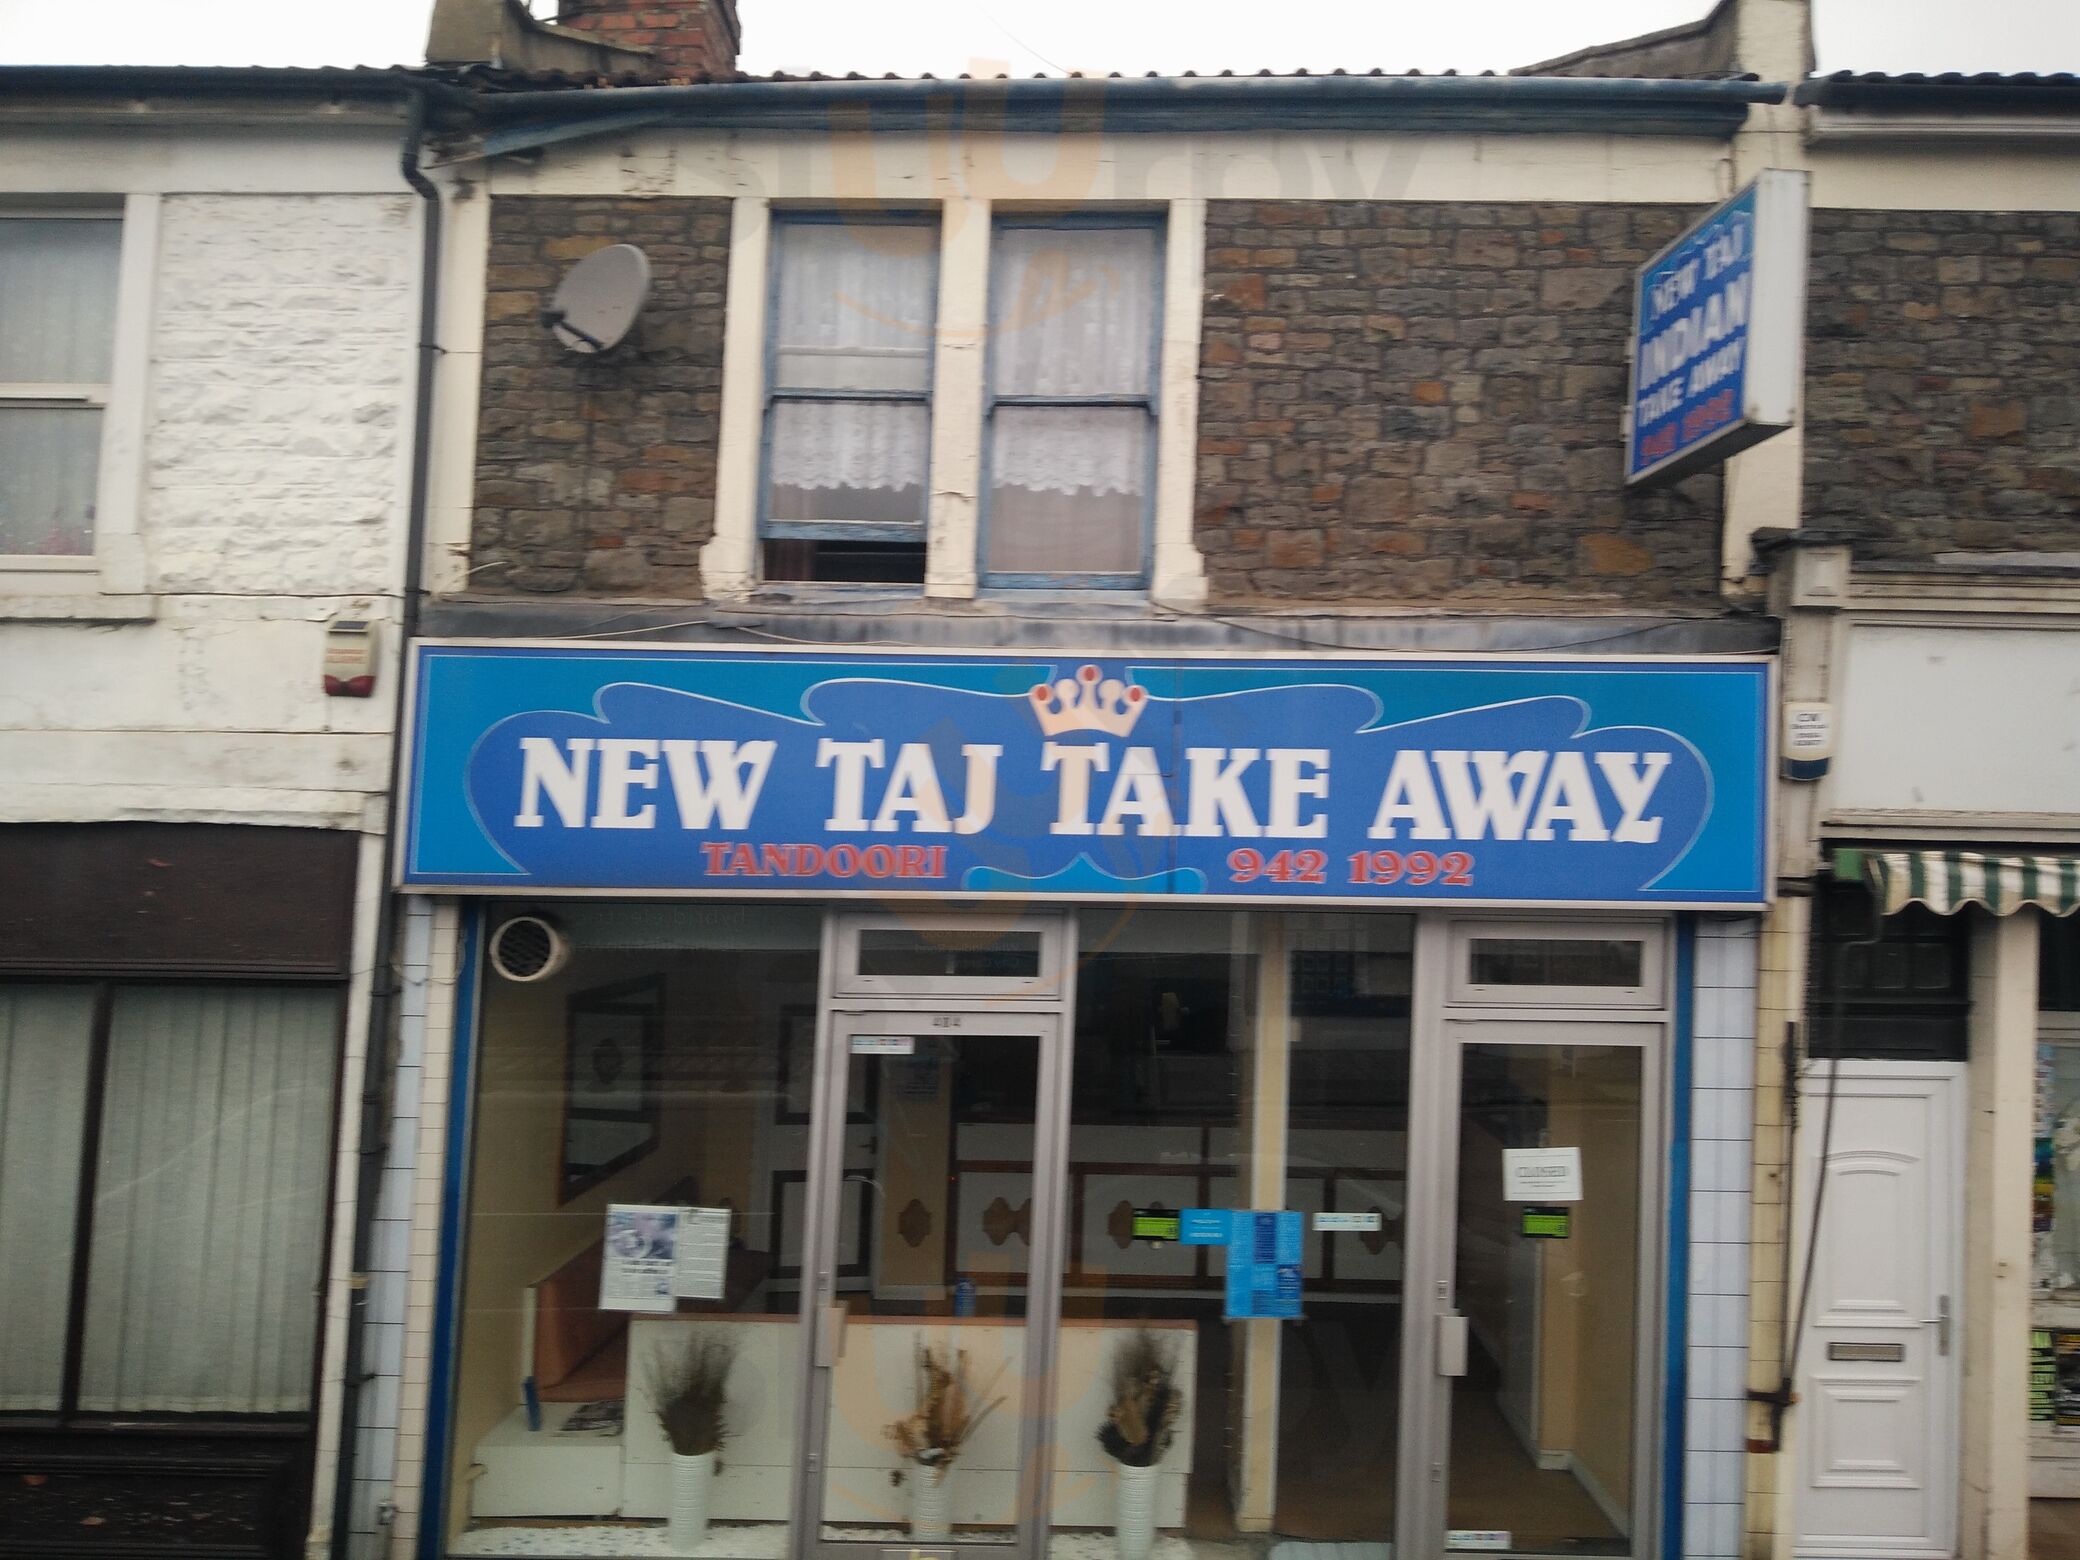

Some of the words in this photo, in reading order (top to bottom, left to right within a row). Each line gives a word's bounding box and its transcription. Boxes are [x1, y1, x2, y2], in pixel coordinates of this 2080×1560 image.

[1651, 257, 1700, 320] NEW
[1639, 271, 1750, 391] INDIAN
[514, 736, 778, 831] NEW
[816, 737, 1004, 835] TAJ
[1041, 741, 1330, 839] TAKE
[1368, 748, 1673, 844] AWAY
[701, 841, 948, 878] TANDOORI
[1227, 847, 1328, 884] 942
[1346, 849, 1476, 886] 1992
